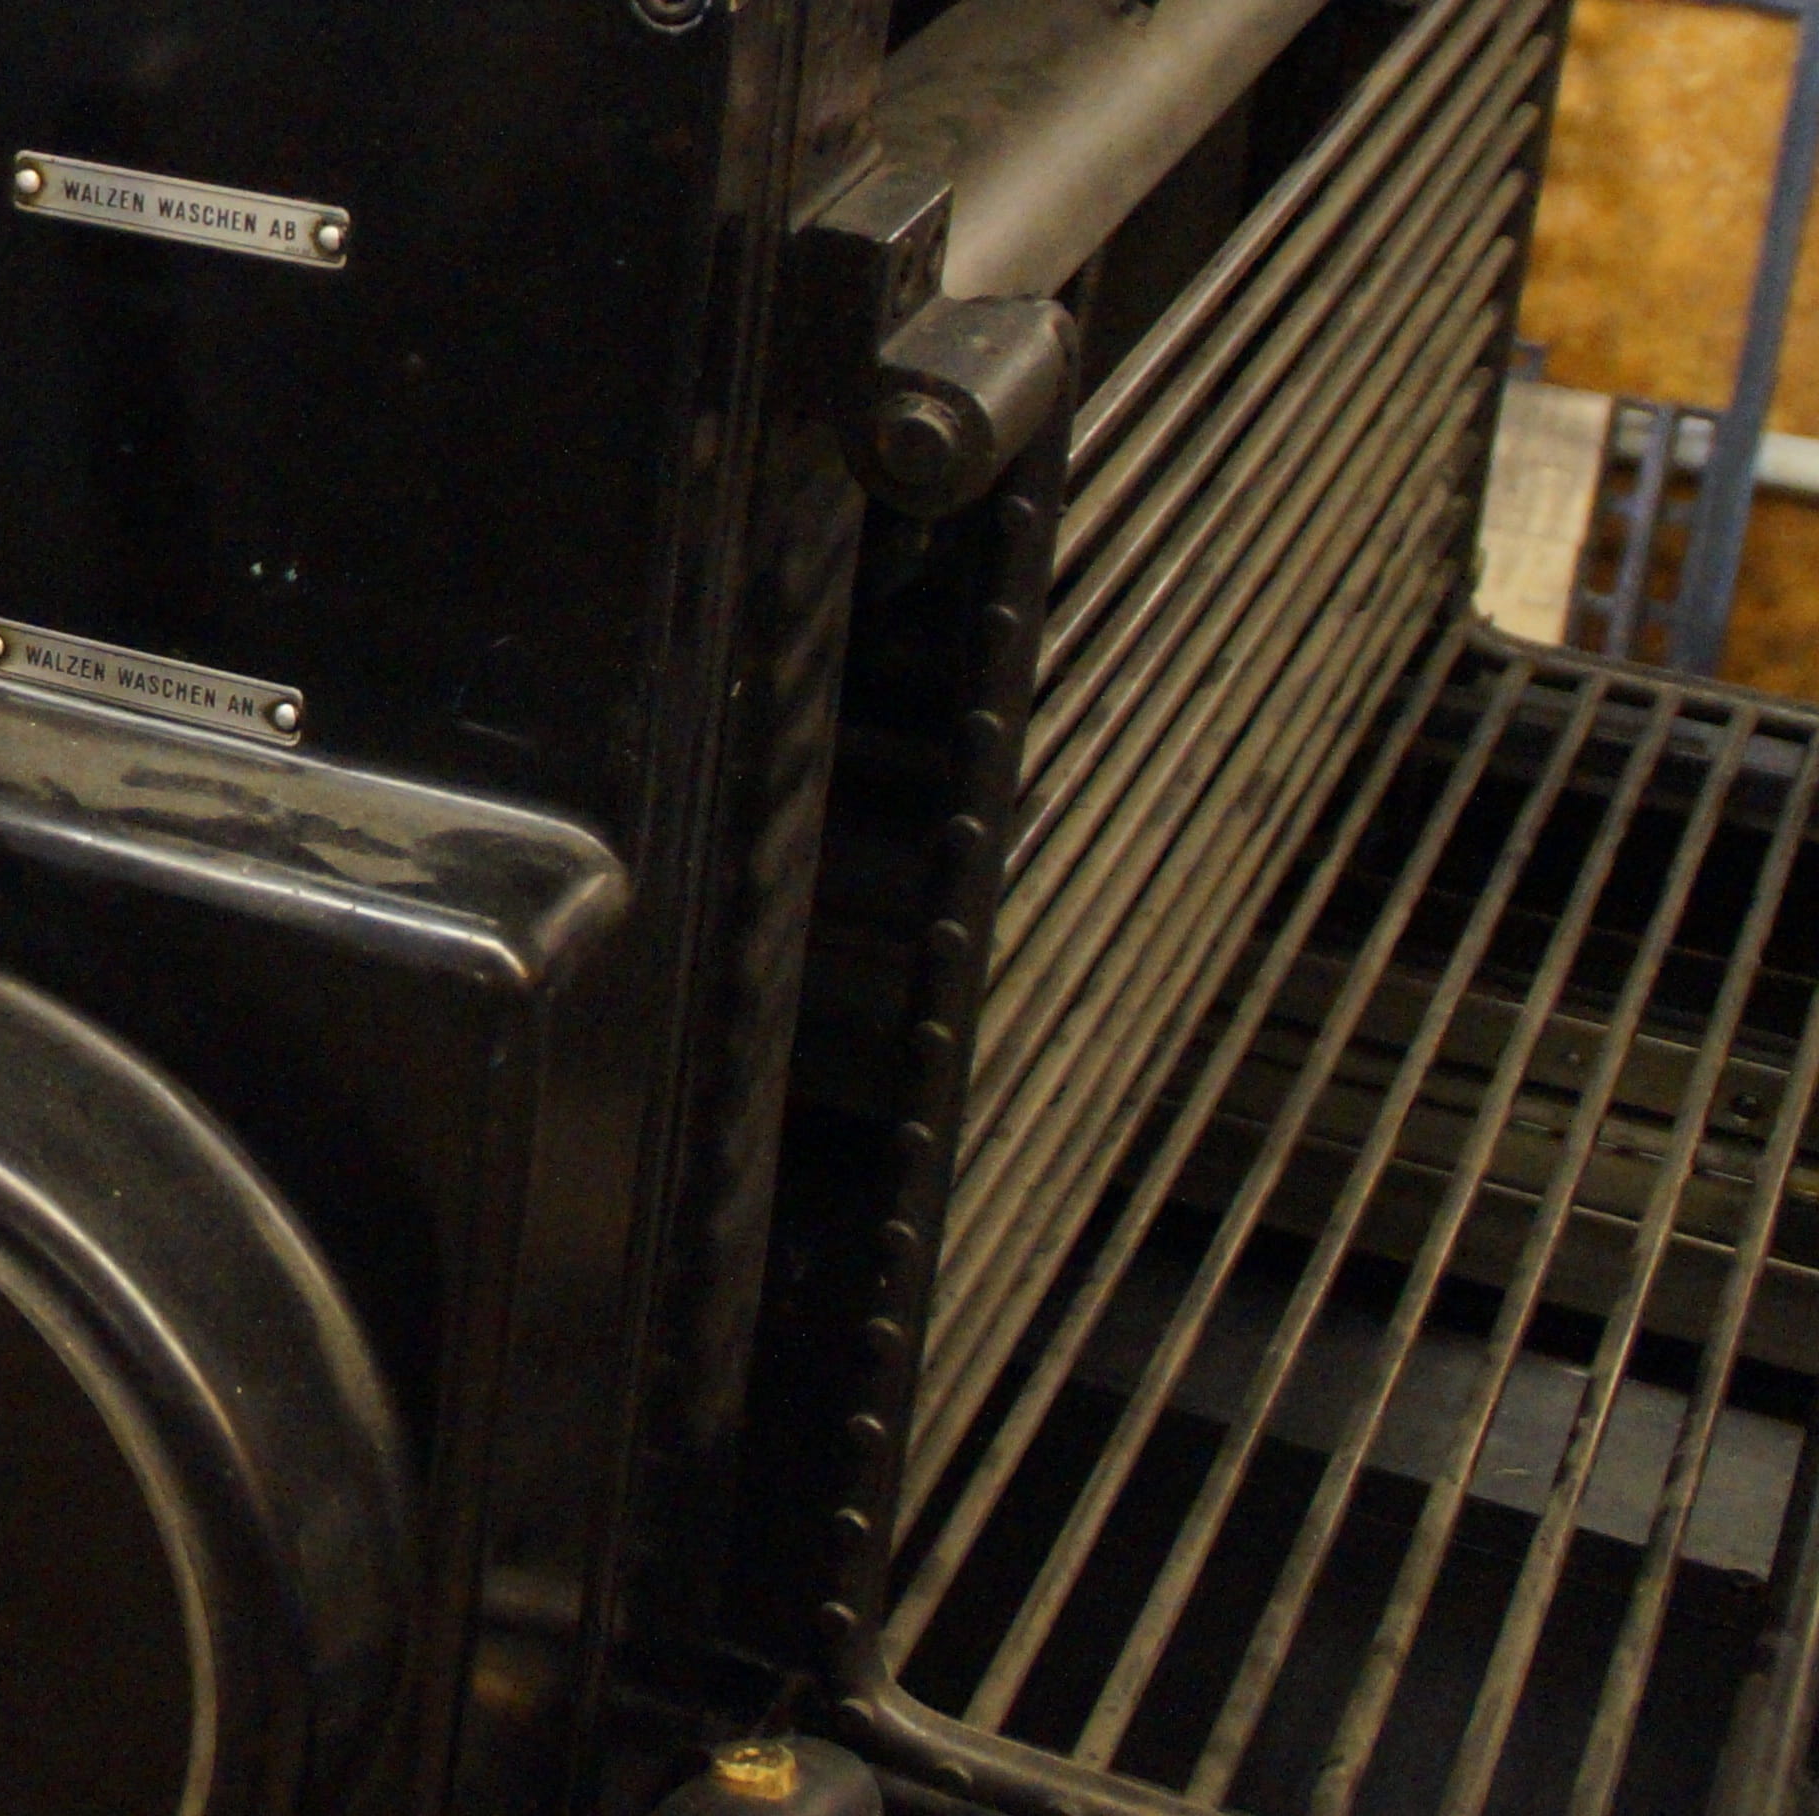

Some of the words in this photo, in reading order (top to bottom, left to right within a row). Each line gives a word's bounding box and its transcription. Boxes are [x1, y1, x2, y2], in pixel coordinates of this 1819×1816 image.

[63, 178, 145, 213] WALZEN
[158, 198, 257, 234] WASCHEN
[269, 218, 297, 241] AB
[25, 644, 105, 682] WALZEN
[117, 668, 216, 709] WASCHEN
[227, 693, 254, 718] AN
